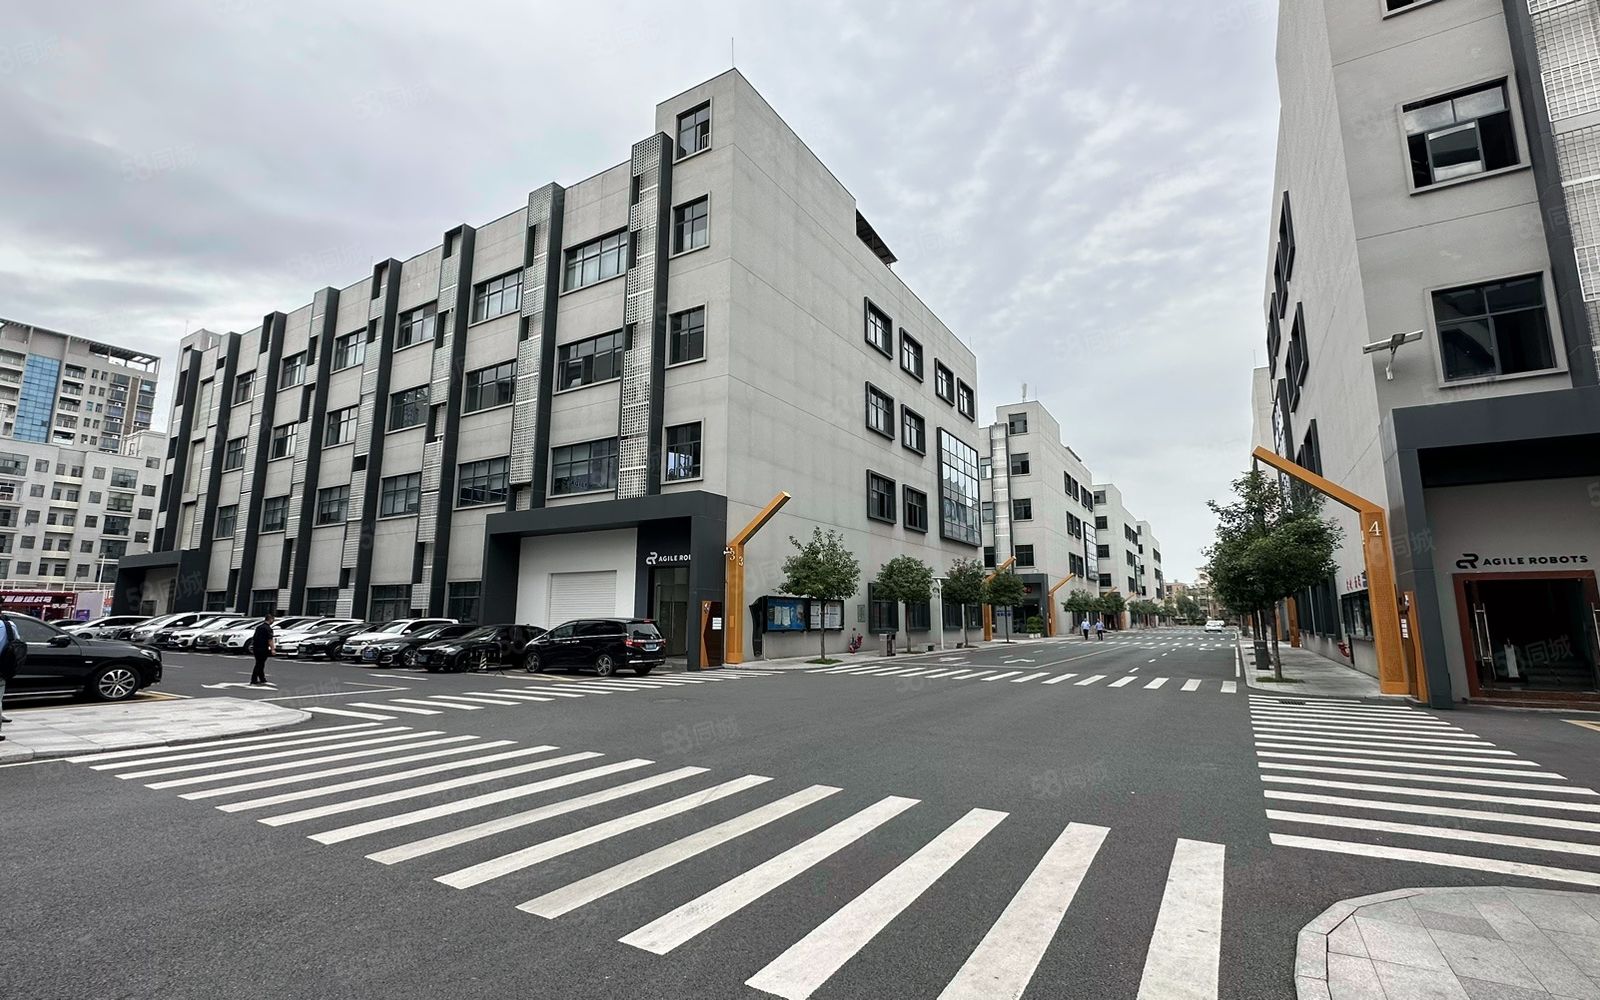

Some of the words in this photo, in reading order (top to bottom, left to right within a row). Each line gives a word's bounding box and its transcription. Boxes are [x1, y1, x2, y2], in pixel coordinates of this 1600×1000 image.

[1369, 520, 1382, 536] 4
[1483, 557, 1524, 566] AGILE
[1529, 555, 1589, 565] ROBOTS
